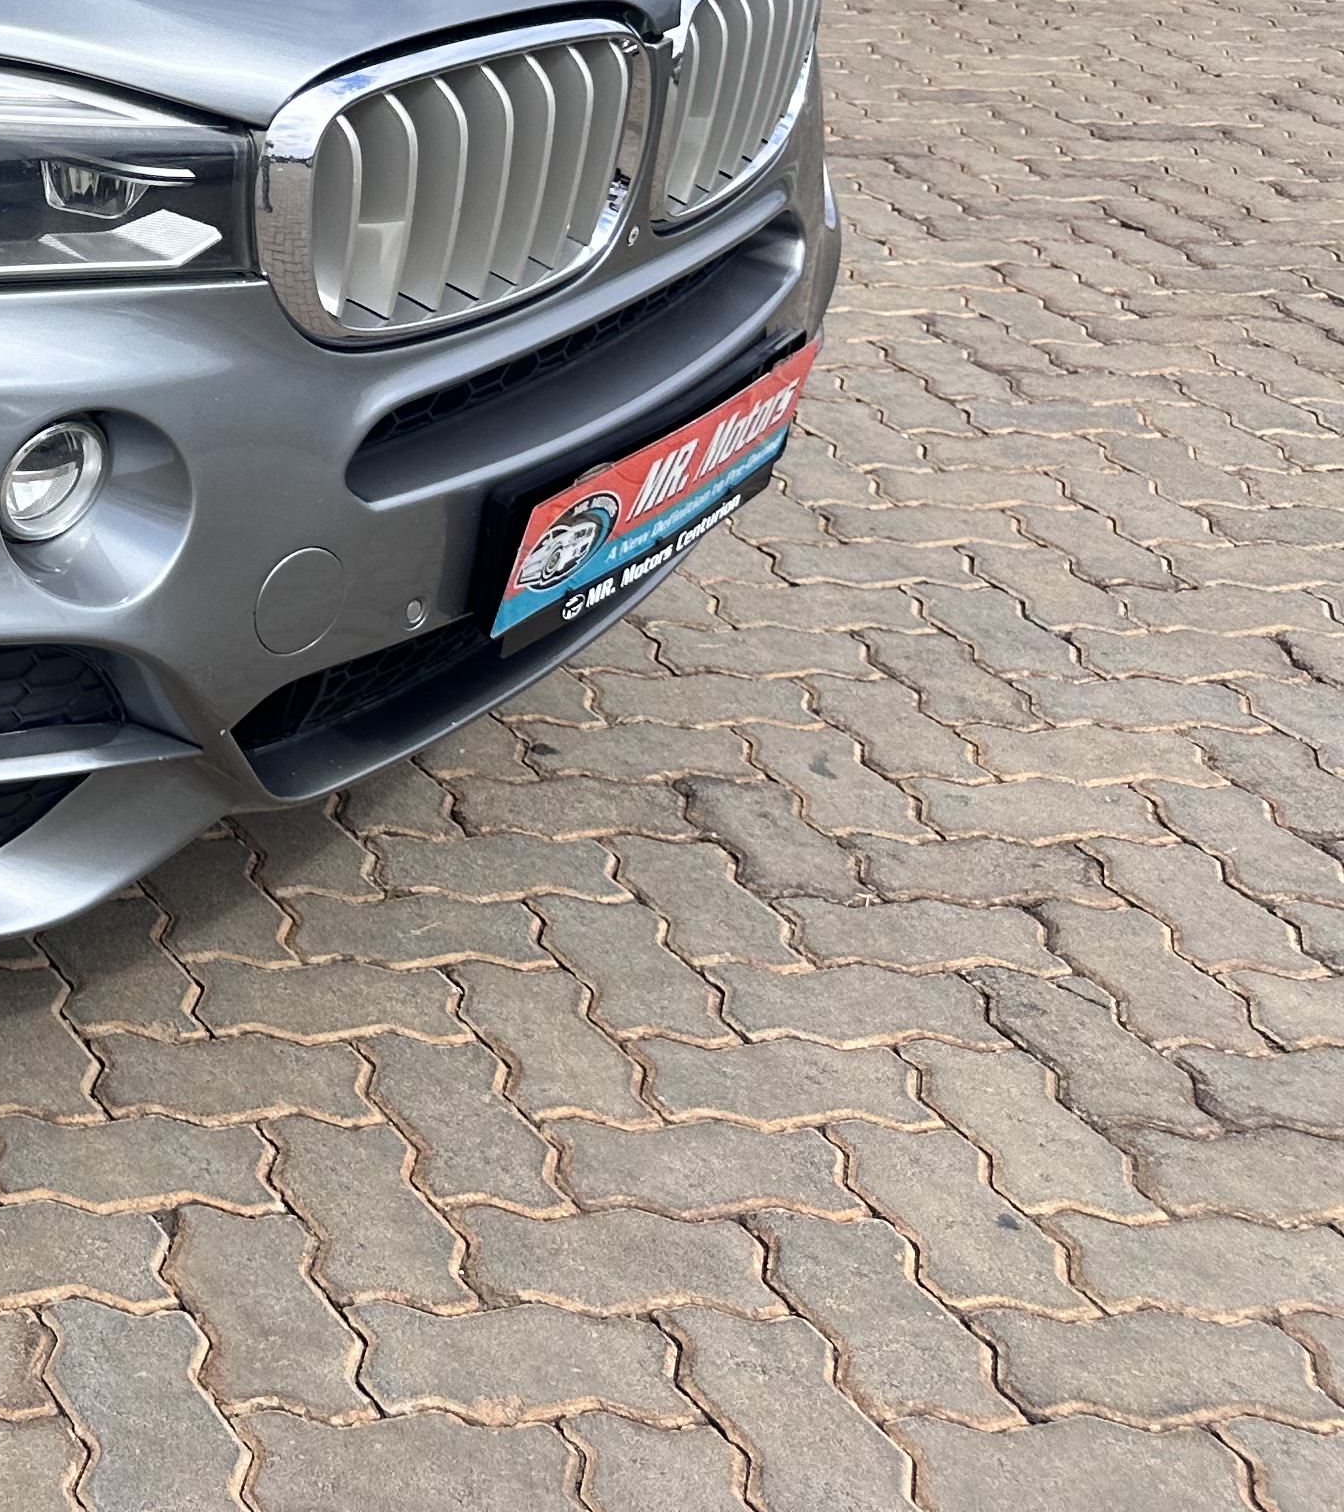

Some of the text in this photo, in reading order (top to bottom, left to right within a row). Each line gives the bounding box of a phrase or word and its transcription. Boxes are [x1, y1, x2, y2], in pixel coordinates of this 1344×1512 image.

[625, 377, 800, 523] MR. Motors
[586, 493, 741, 607] MR. Motors Centurion
